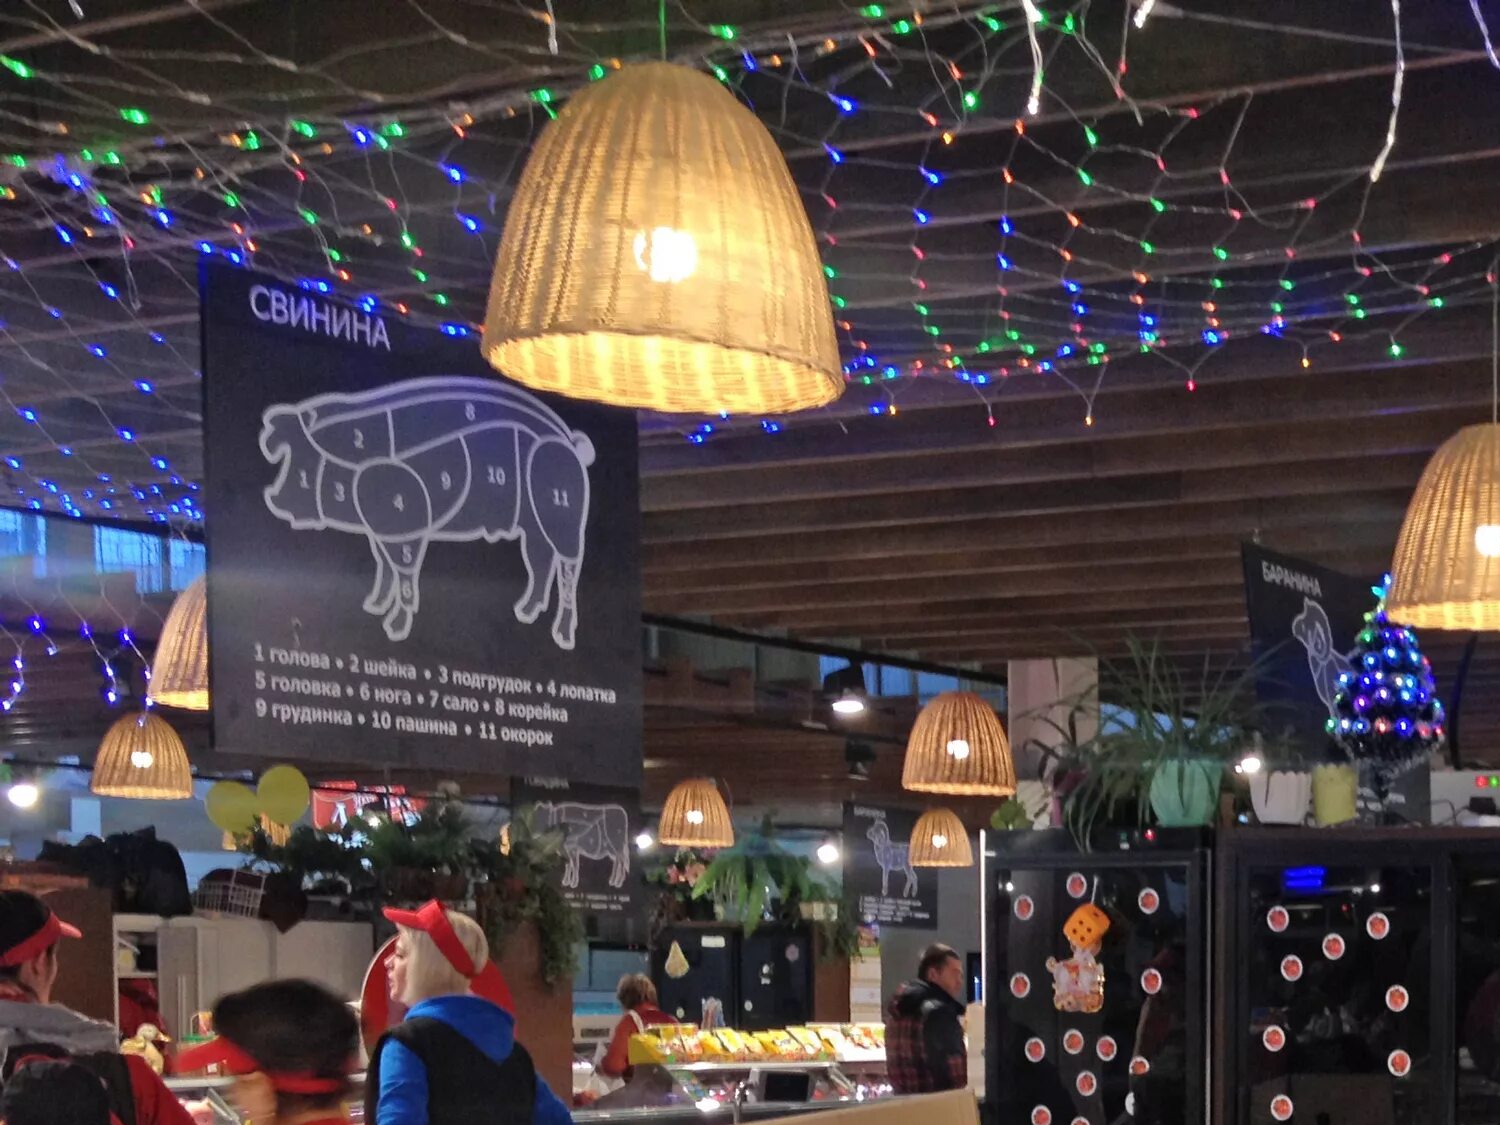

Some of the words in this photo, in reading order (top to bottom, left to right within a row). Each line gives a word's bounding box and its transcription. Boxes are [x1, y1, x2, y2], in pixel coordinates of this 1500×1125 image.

[250, 286, 391, 351] СВИНИНА
[354, 429, 364, 449] 2
[299, 470, 310, 490] 1
[487, 465, 506, 486] 10
[334, 482, 345, 502] 3
[552, 489, 569, 507] 11
[255, 643, 265, 662] 1
[269, 647, 331, 670] голова
[350, 654, 360, 674] 2
[364, 660, 417, 681] шейка
[438, 665, 449, 684] 3
[452, 671, 532, 695] подгрудок
[547, 680, 557, 697] 4
[560, 683, 616, 704] лопатка
[255, 671, 266, 690] 5
[271, 674, 341, 699] головка
[360, 682, 371, 701] 6
[375, 686, 411, 706] нога
[430, 690, 440, 709] 7
[443, 694, 479, 714] сало
[494, 698, 505, 717] 8
[508, 701, 568, 724] корейка
[255, 698, 267, 718] 9
[272, 703, 352, 727] грудинка
[371, 711, 392, 730] 10
[395, 715, 457, 737] пашина
[479, 722, 498, 741] 11
[501, 727, 553, 748] окорок
